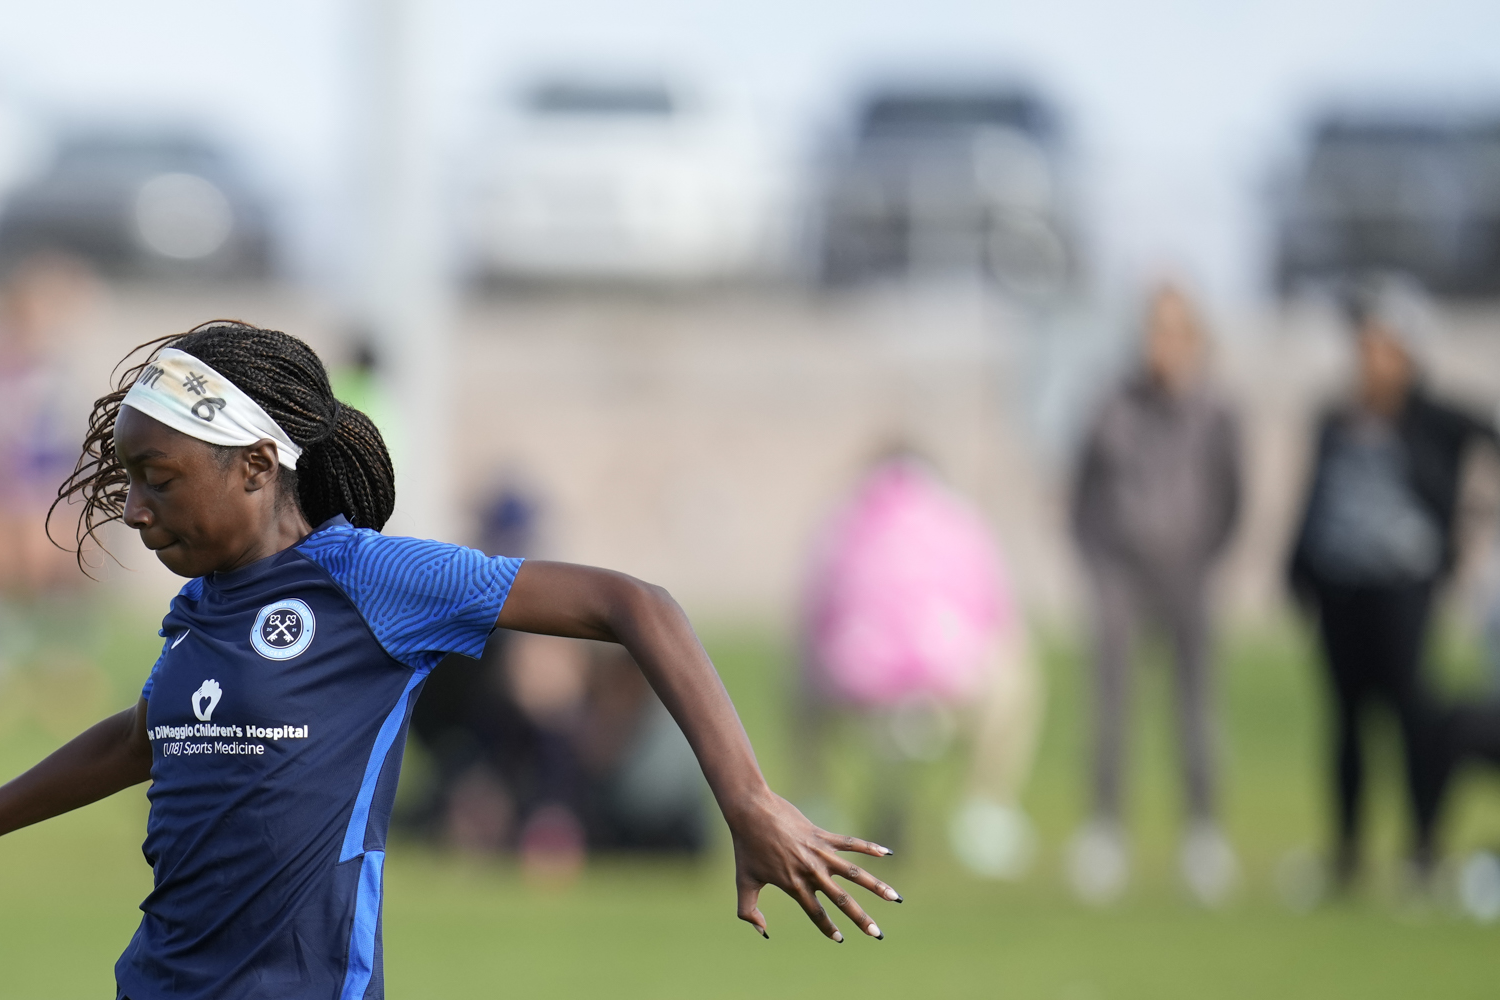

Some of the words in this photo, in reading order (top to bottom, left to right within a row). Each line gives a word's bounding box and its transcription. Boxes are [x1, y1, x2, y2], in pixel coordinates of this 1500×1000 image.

[289, 602, 308, 617] UNITED
[258, 643, 283, 656] SOCCER
[284, 644, 302, 656] CLUB
[155, 724, 193, 740] DiMaggio
[194, 723, 243, 738] Children's
[245, 724, 309, 740] Hospital
[163, 742, 183, 757] [U18]
[183, 741, 213, 756] Sports
[214, 741, 265, 755] Medicine
